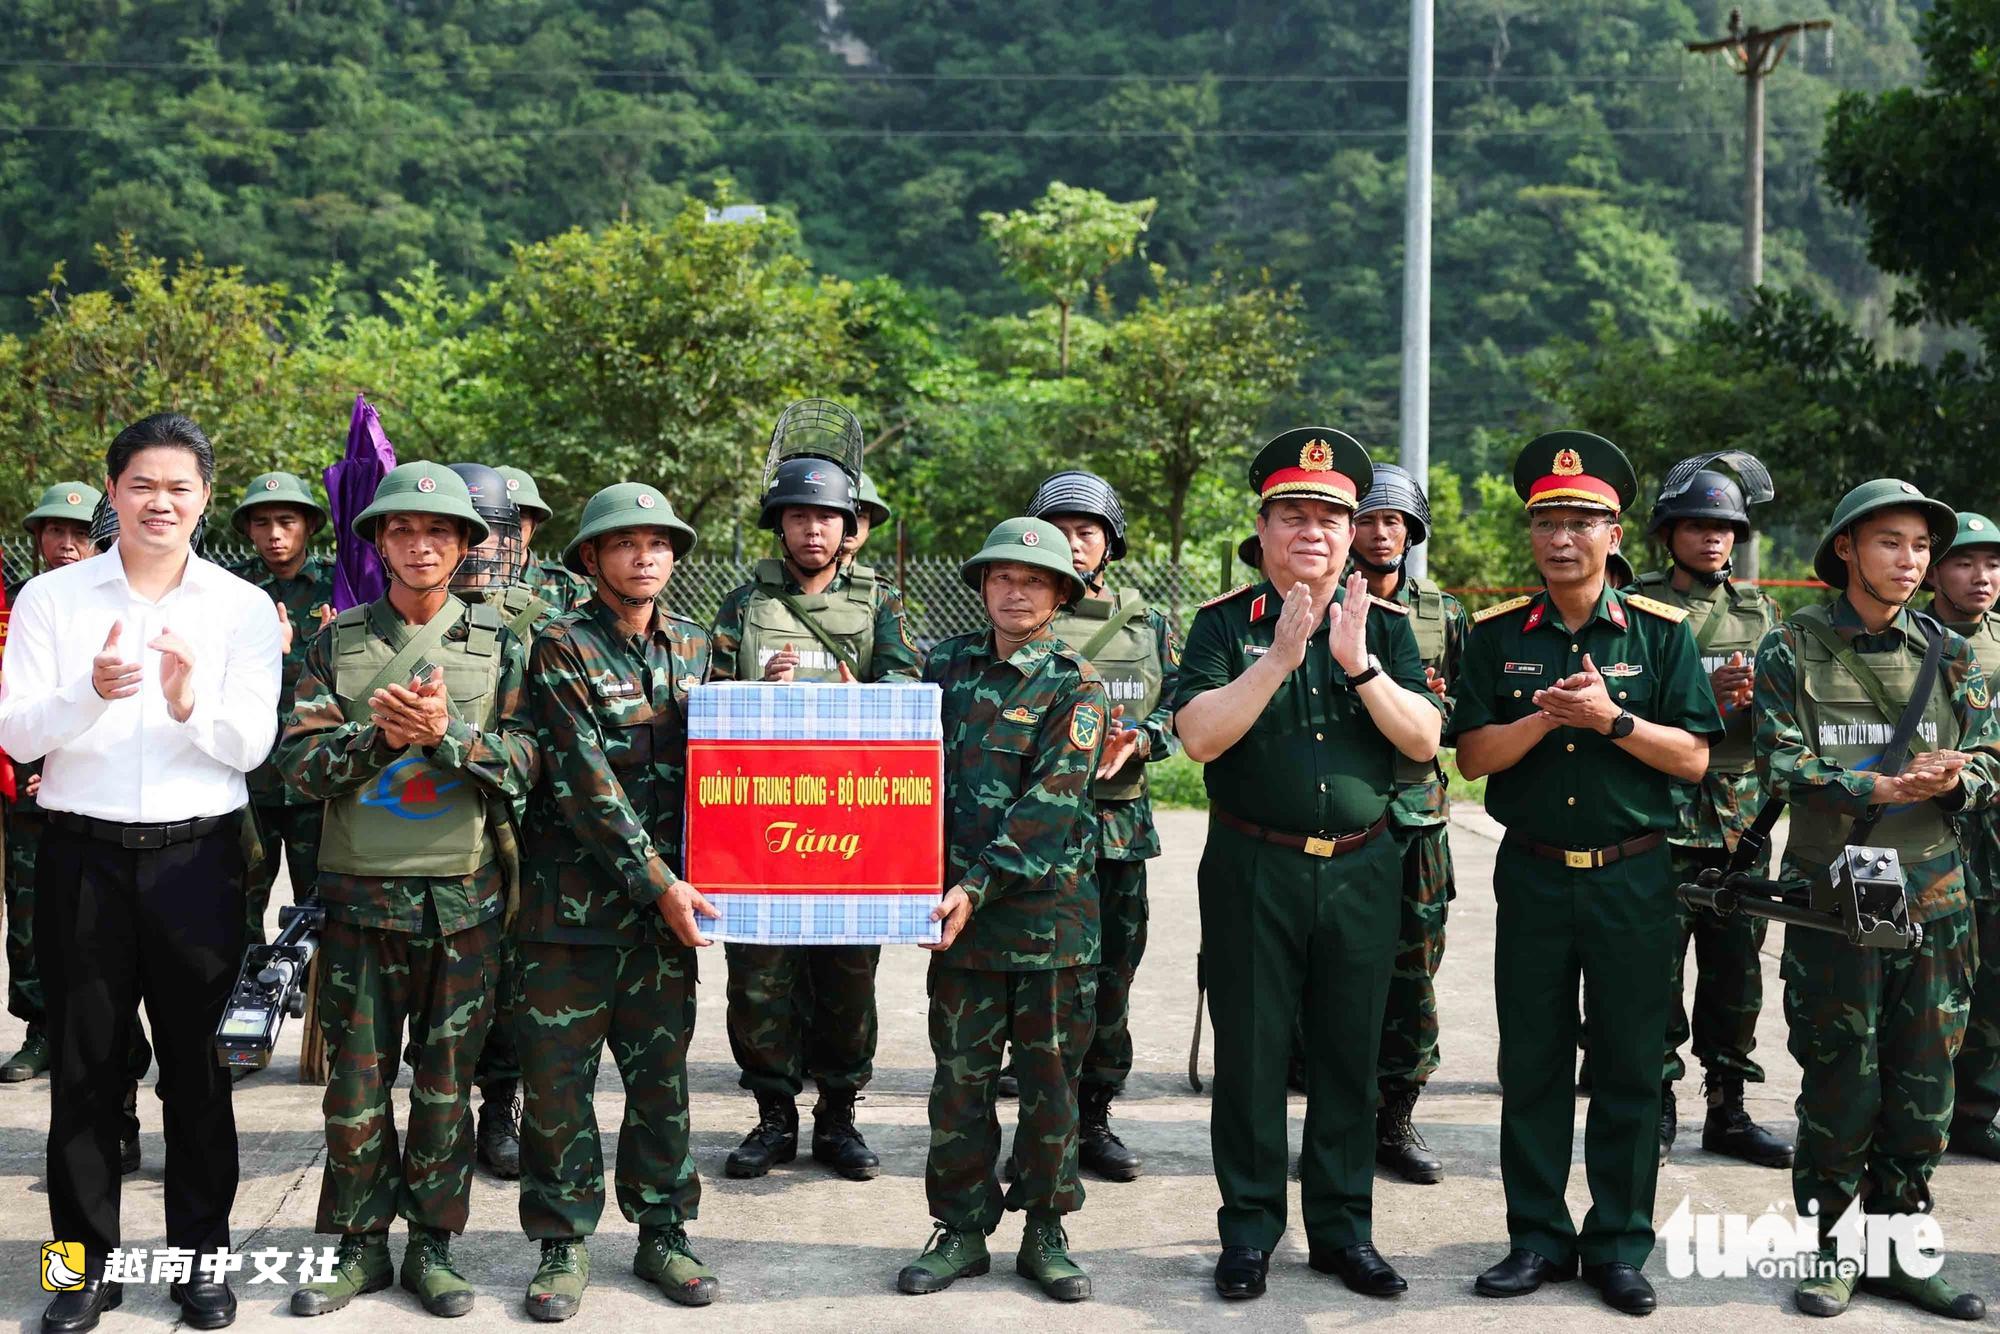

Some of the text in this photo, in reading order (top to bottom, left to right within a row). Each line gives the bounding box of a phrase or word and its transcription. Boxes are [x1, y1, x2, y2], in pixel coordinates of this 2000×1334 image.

[1133, 681, 1144, 700] 319
[1819, 721, 1837, 746] CÔNG
[1838, 724, 1847, 745] TY
[1858, 719, 1867, 744] LÝ
[1867, 723, 1884, 744] BOM
[1925, 721, 1937, 743] 319
[699, 769, 732, 808] QUÂN
[734, 766, 750, 806] ỦY
[752, 776, 791, 806] TRUNG
[794, 773, 827, 806] ƯƠNG
[838, 770, 854, 812] BỘ
[857, 766, 889, 809] QUỐC
[891, 769, 932, 806] PHÒNG
[764, 821, 862, 860] Tặng
